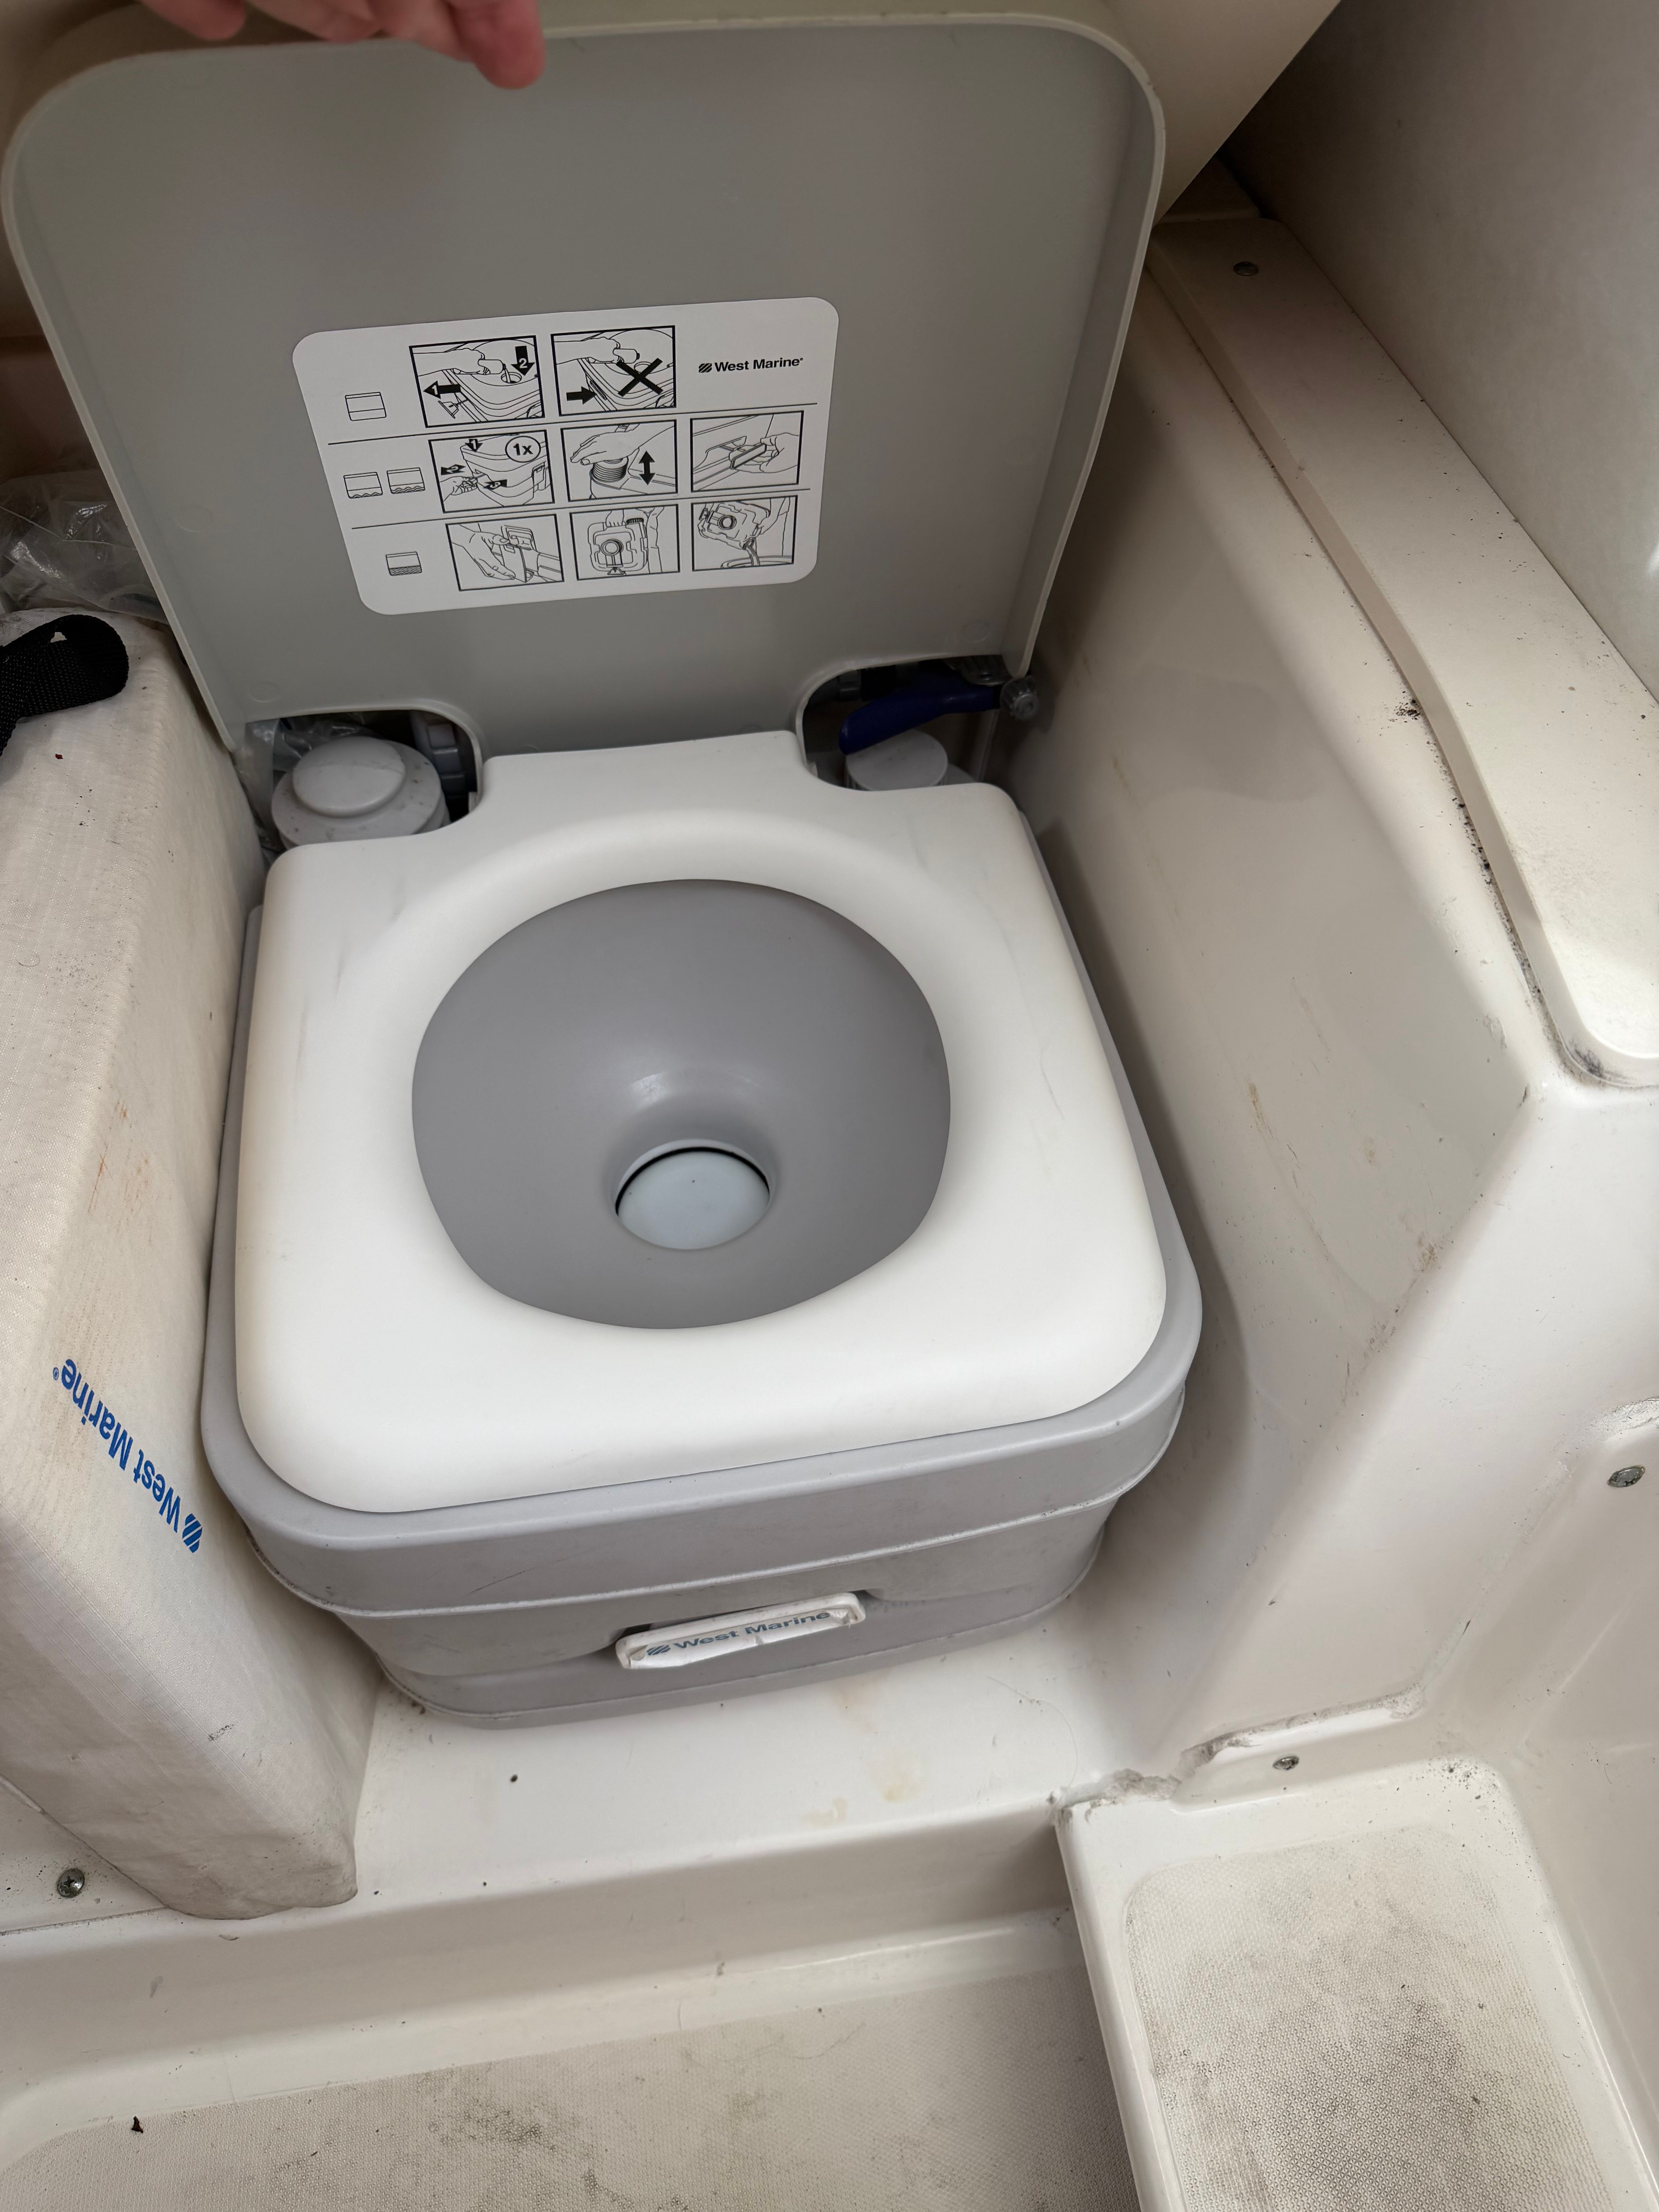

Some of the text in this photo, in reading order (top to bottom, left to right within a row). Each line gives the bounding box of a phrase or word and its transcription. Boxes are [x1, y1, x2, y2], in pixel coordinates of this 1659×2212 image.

[519, 358, 528, 369] 2
[714, 361, 749, 372] West
[432, 385, 438, 395] 1
[471, 440, 477, 449] 1
[513, 443, 533, 456] 1x
[133, 1449, 181, 1534] West
[674, 1611, 831, 1649] West Marine
